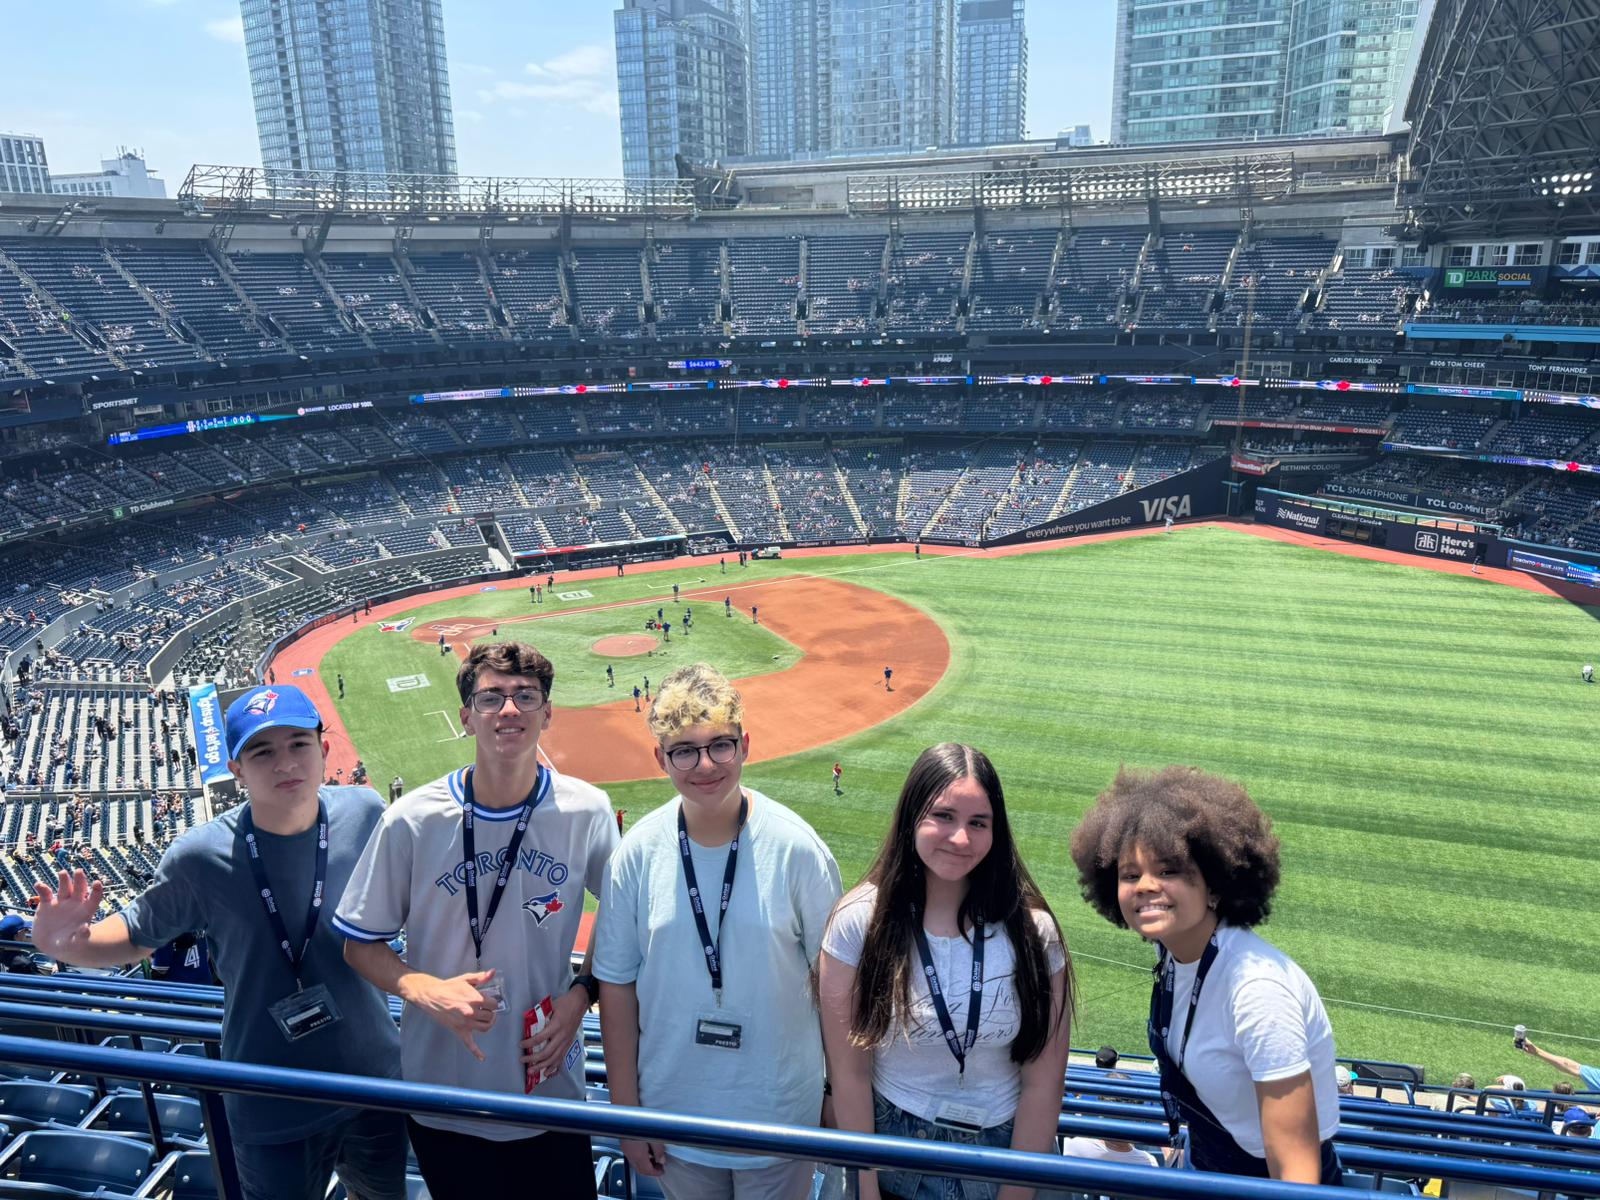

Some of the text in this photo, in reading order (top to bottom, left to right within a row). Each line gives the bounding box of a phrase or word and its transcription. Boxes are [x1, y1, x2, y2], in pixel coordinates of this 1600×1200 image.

[1447, 271, 1532, 284] TD PARK SOCIAL
[92, 398, 138, 410] SPORTSNET
[328, 403, 352, 411] LOCATED
[1326, 484, 1408, 501] TCL SMARTPHONE
[130, 499, 174, 514] TD Clubhouse
[1139, 494, 1191, 522] VISA
[1426, 498, 1447, 508] TCL
[1286, 510, 1319, 525] National
[1026, 525, 1074, 539] everywhere
[1075, 522, 1090, 533] you
[1091, 519, 1110, 529] want
[1121, 515, 1131, 524] be
[1441, 535, 1474, 548] Here's
[1440, 546, 1466, 557] How.
[1513, 557, 1535, 566] TORONTO
